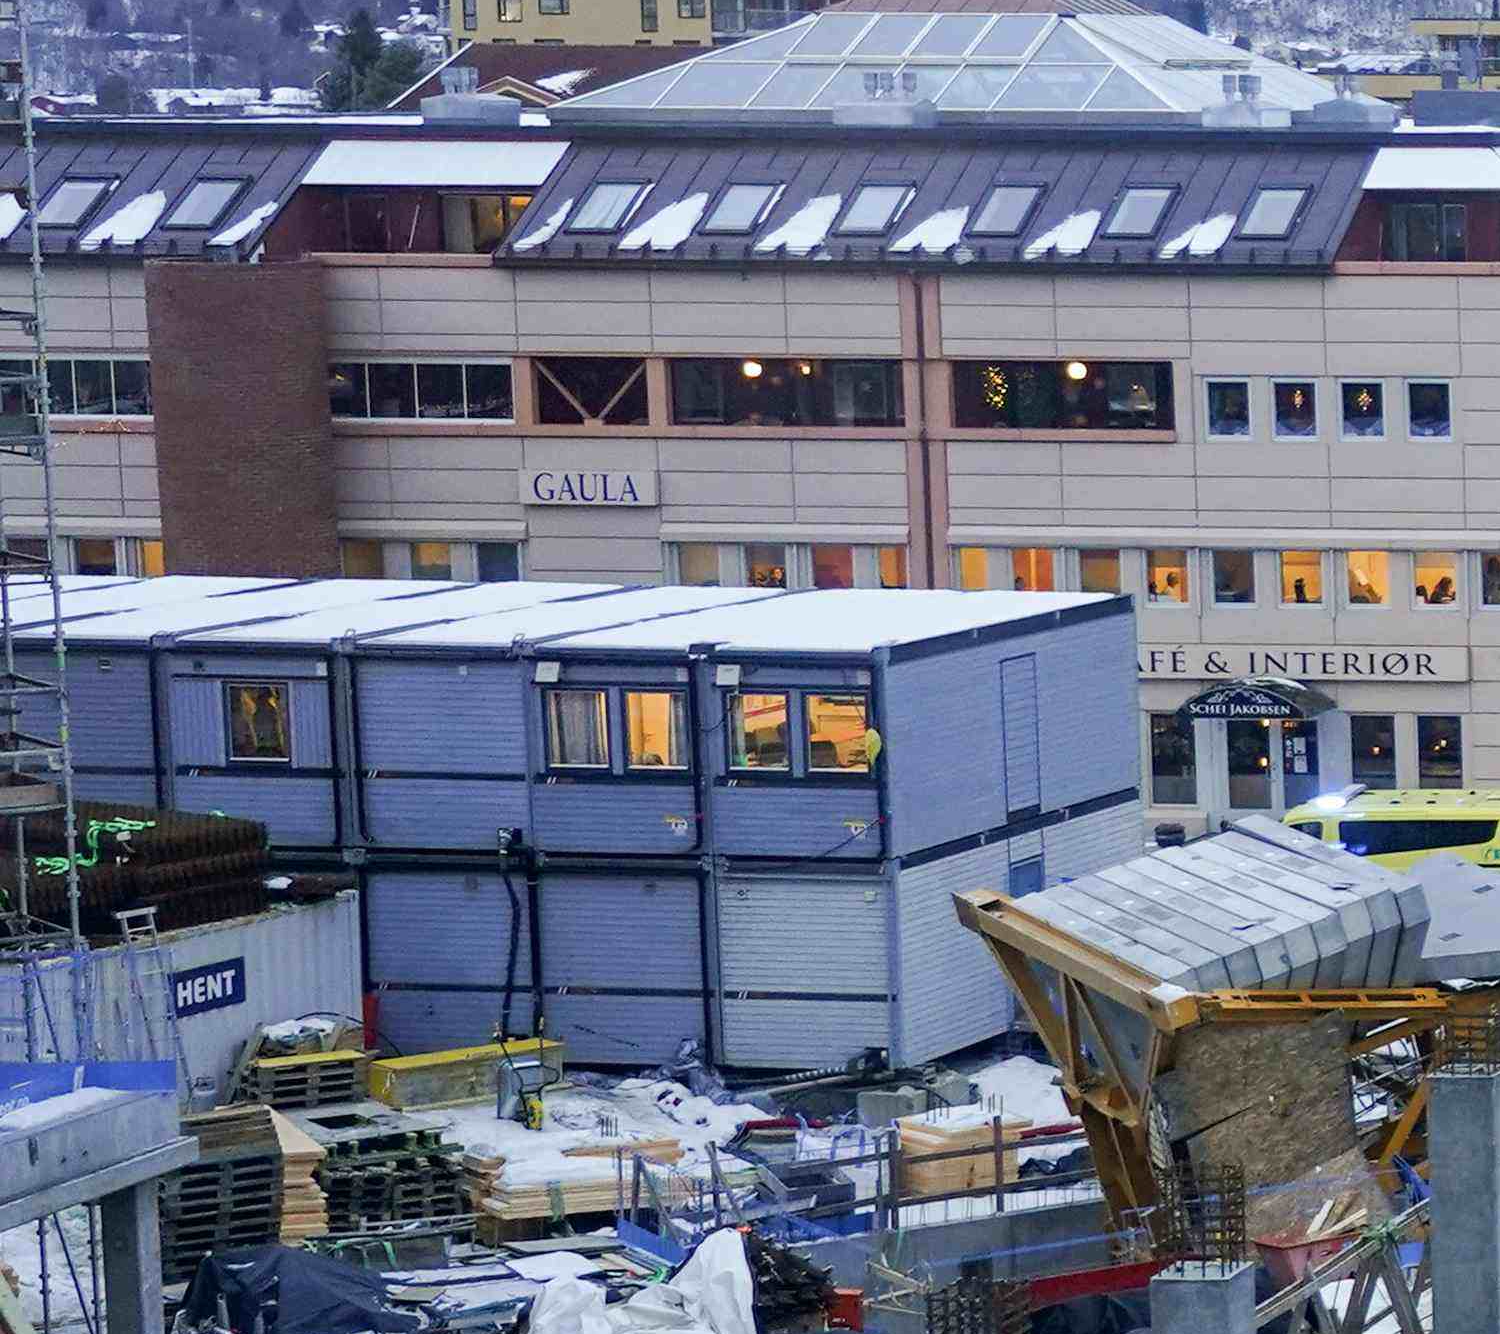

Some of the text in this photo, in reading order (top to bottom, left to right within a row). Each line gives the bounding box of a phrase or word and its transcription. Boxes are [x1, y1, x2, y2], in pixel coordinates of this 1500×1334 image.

[533, 471, 639, 502] GAULA
[1204, 651, 1230, 674] &
[1248, 651, 1437, 676] INTERIØR
[1229, 702, 1292, 718] JAKOBSEN
[177, 969, 236, 1008] HENT
